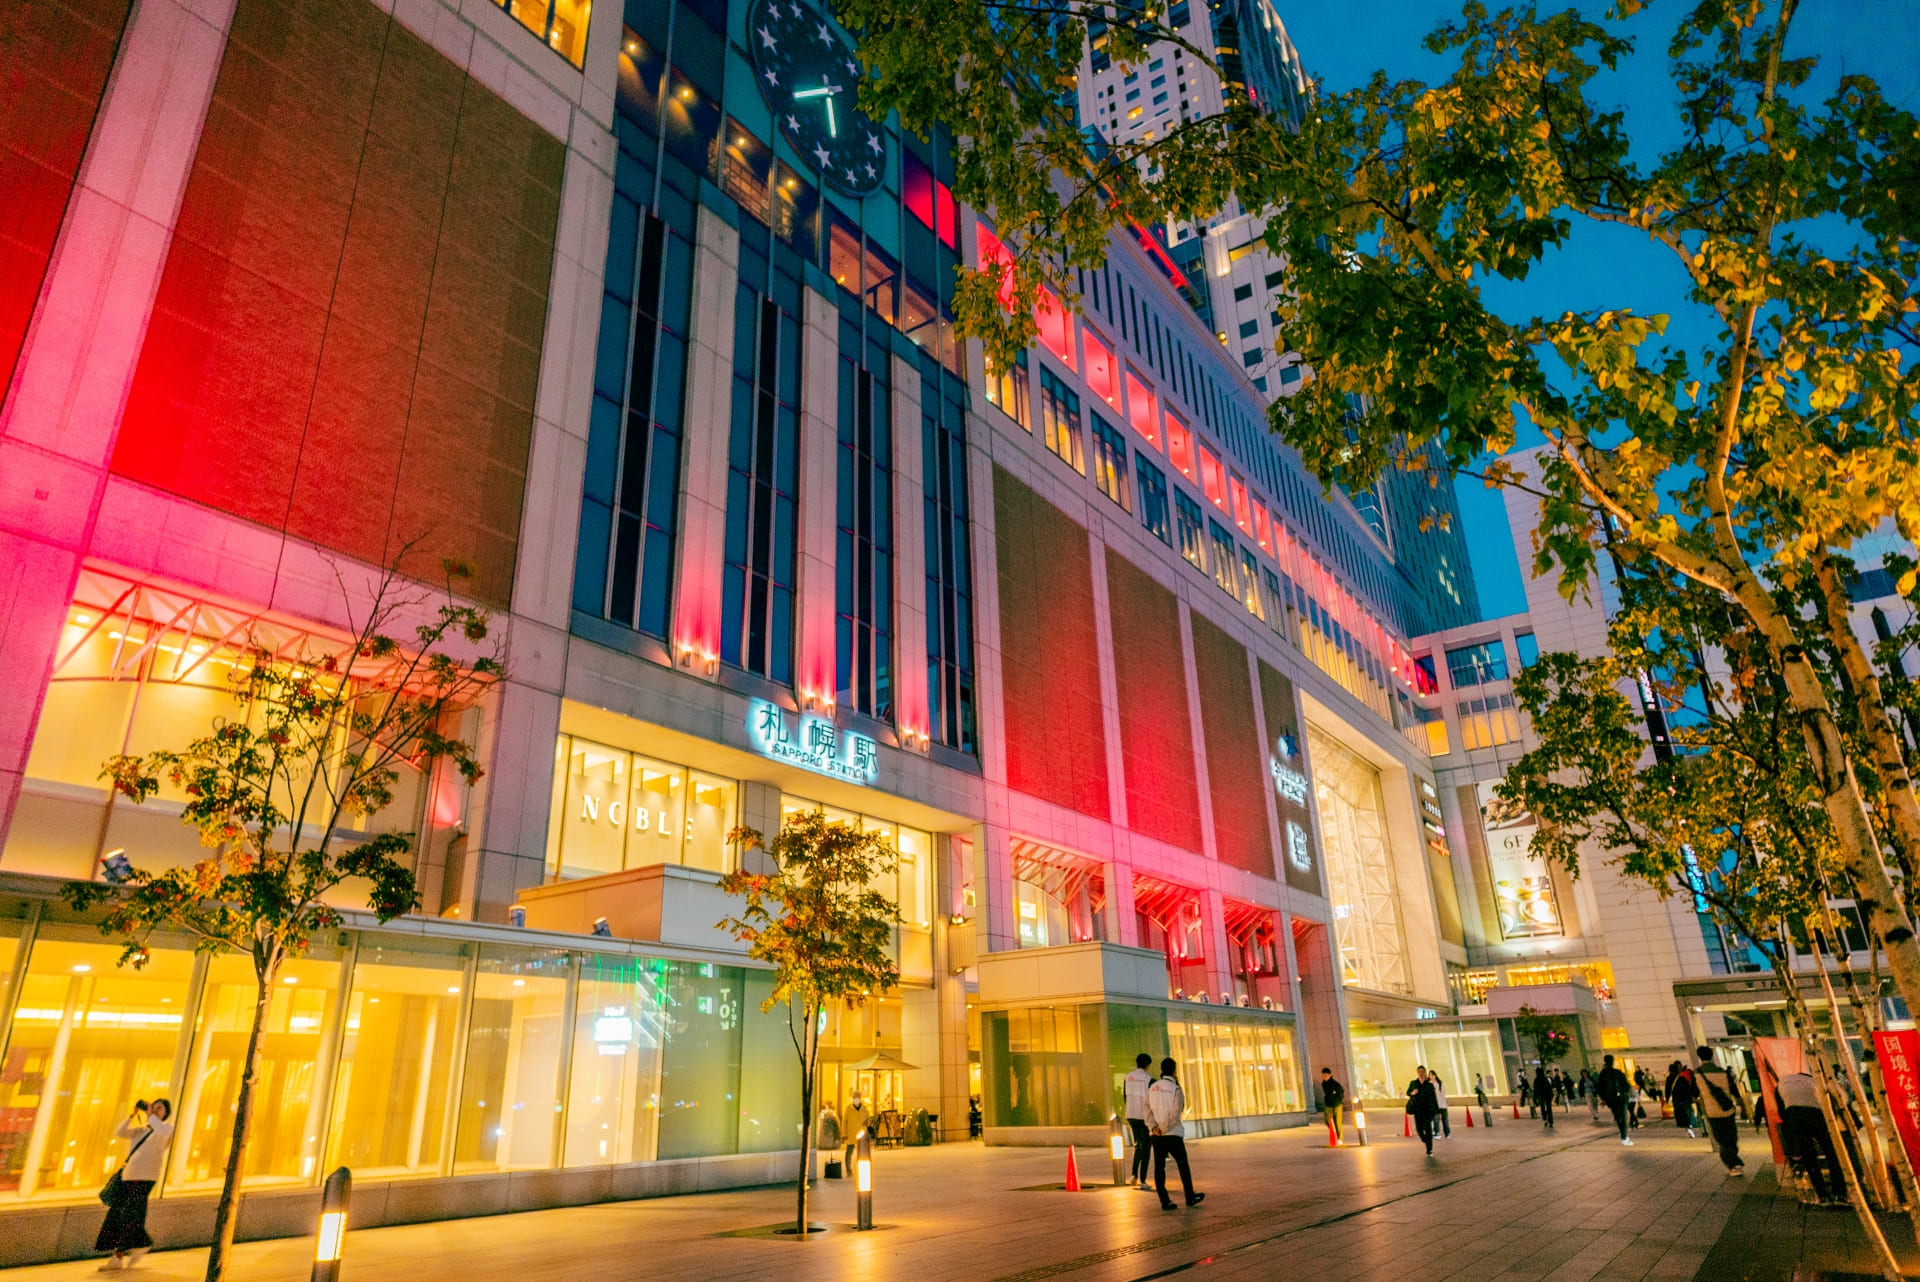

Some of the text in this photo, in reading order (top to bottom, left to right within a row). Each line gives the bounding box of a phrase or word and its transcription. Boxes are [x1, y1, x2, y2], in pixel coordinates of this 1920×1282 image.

[759, 703, 878, 774] 札幌駅
[771, 743, 869, 782] SAPPORO STATION
[1503, 833, 1525, 850] 6F
